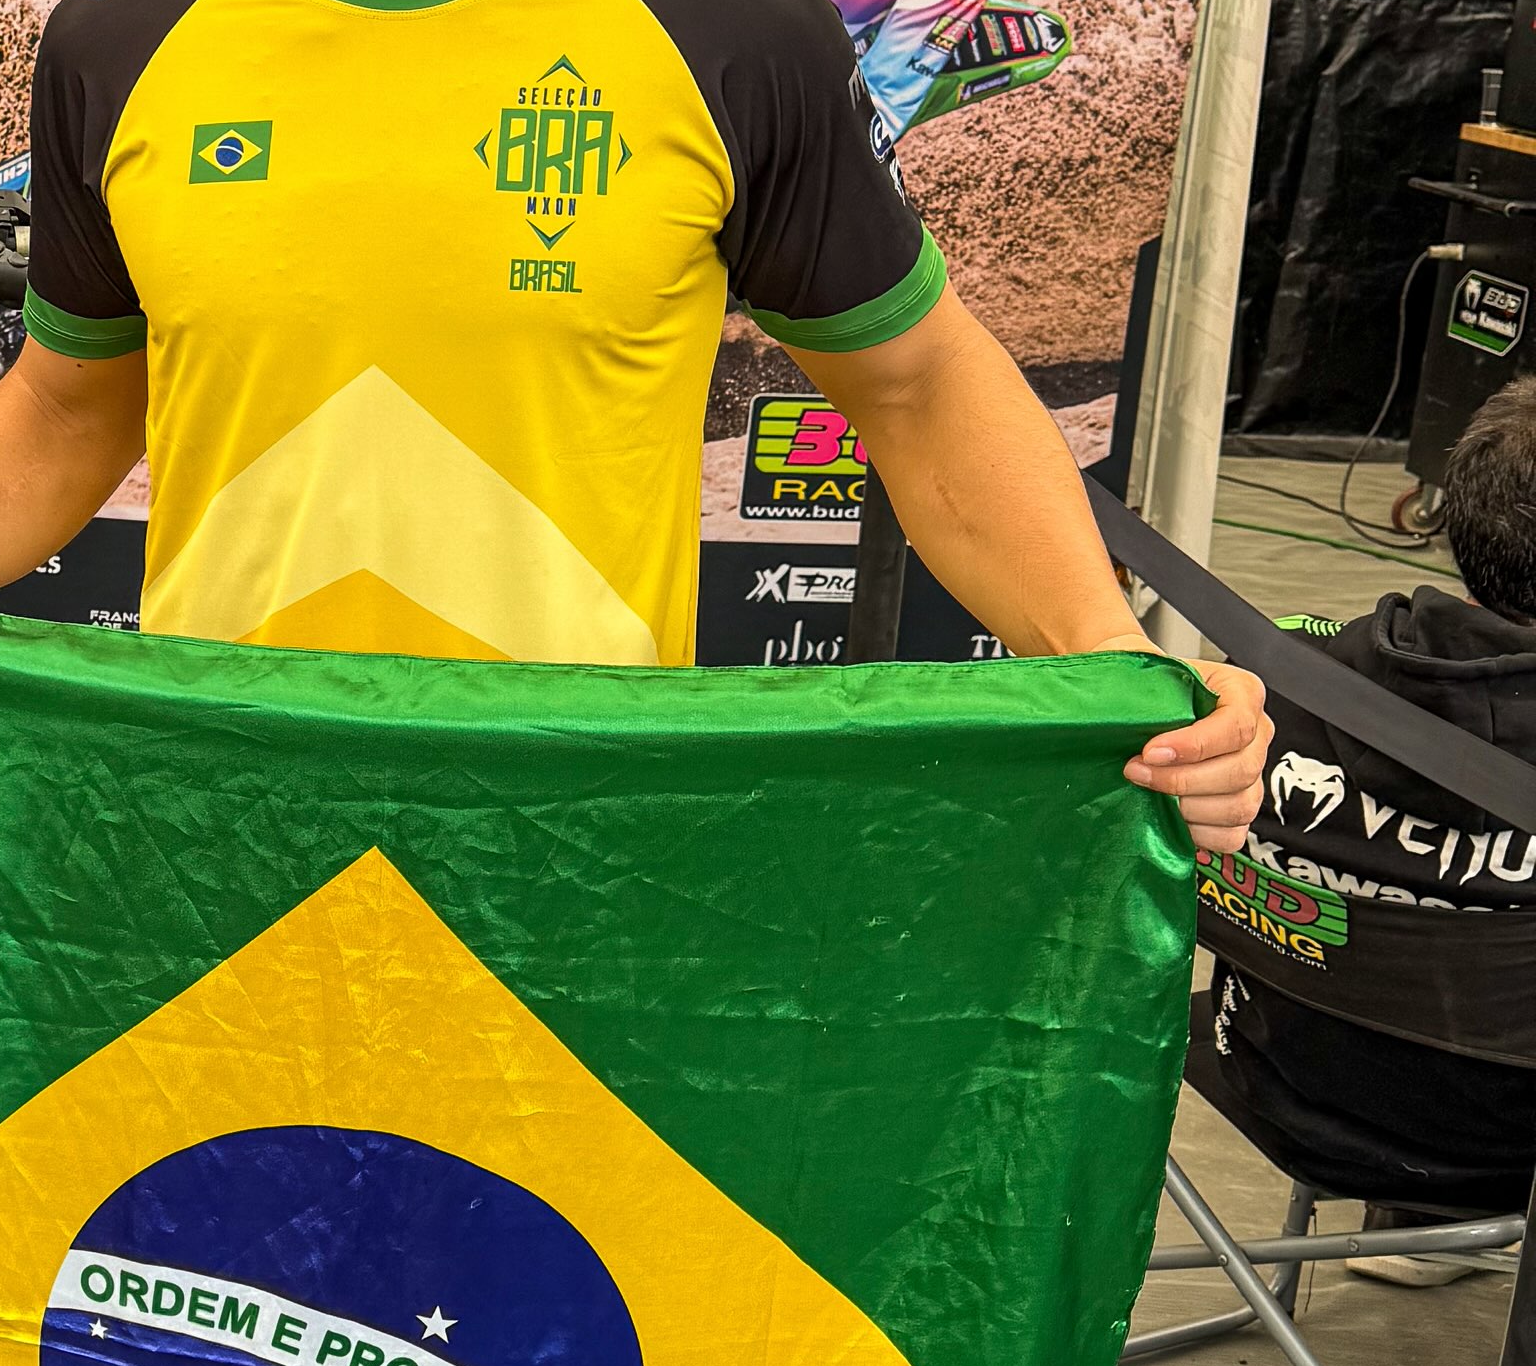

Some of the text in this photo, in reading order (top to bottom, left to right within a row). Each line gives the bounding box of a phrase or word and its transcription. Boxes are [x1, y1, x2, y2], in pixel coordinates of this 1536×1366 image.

[518, 87, 602, 108] SELEÇÃO
[495, 107, 614, 196] BRA
[526, 196, 577, 216] MXON
[509, 259, 583, 294] BRASIL
[745, 505, 860, 520] www.bud
[1200, 879, 1326, 962] ACING
[80, 1264, 260, 1340] ORDEM
[271, 1314, 307, 1356] E
